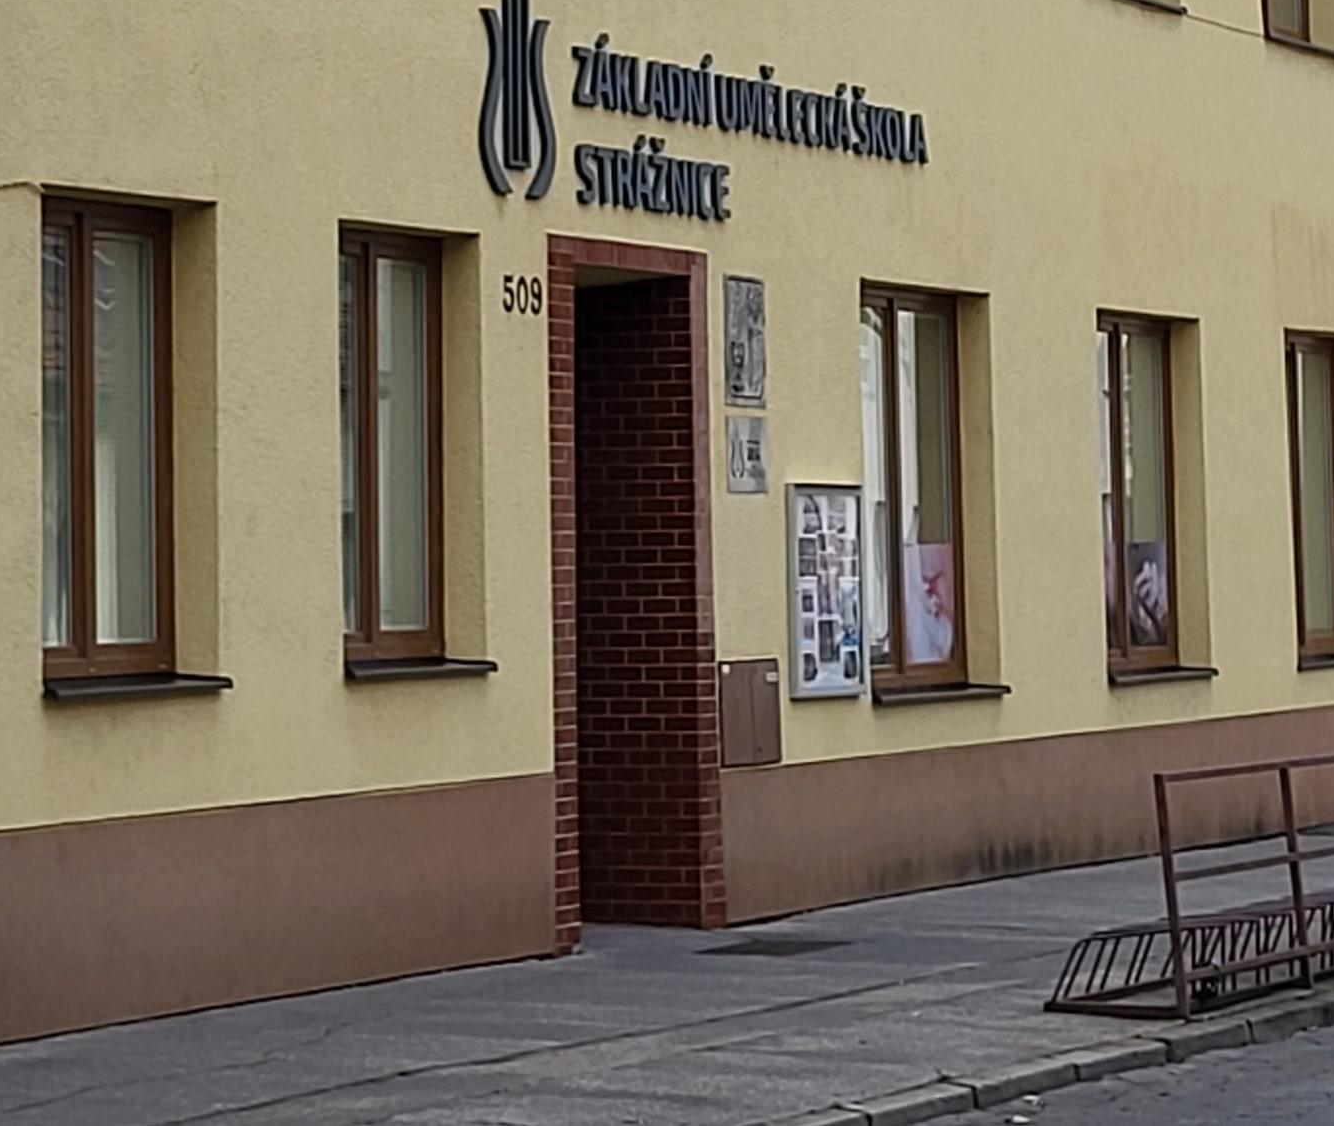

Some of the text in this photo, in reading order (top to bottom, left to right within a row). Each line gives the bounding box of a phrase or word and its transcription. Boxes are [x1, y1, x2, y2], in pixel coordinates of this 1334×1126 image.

[571, 32, 928, 164] ZÁKLADNÍ UMĚLECKÁ ŠKOLA
[574, 134, 731, 222] STRÁŽNICE
[502, 274, 542, 316] 509
